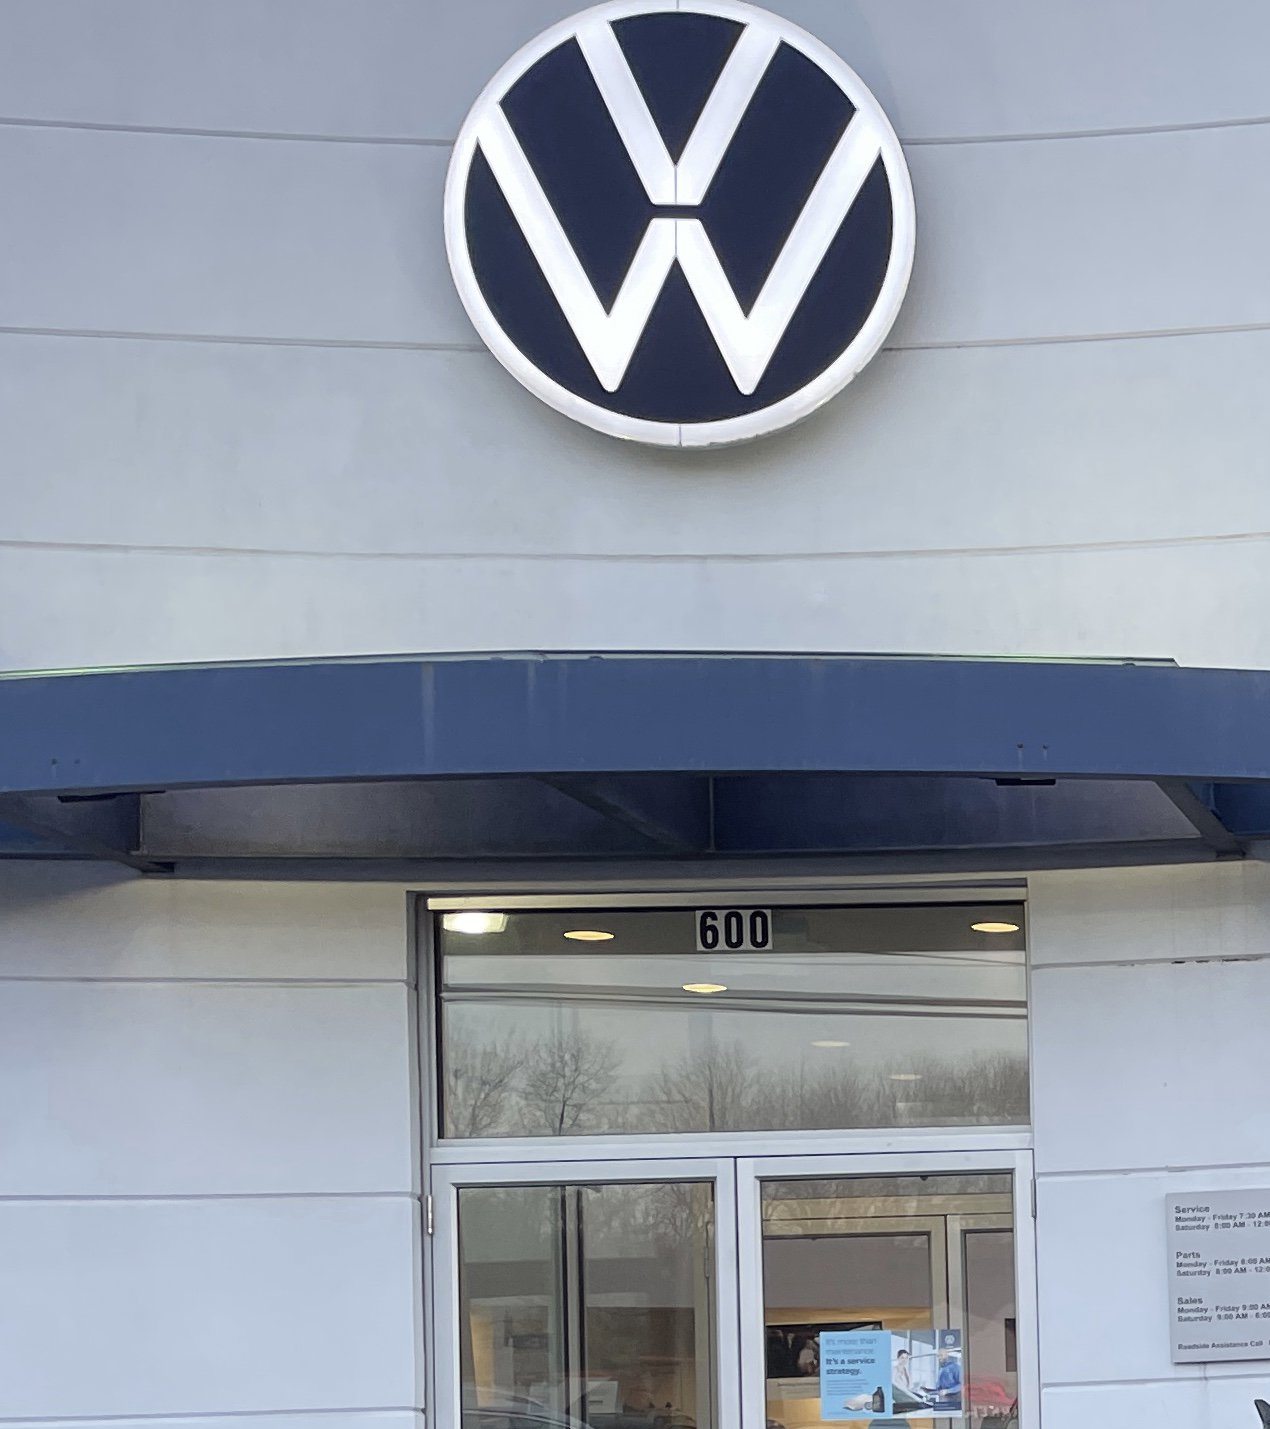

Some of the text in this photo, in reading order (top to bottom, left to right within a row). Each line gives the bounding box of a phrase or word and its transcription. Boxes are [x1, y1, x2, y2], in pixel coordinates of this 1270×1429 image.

[700, 911, 769, 949] 600
[1175, 1215, 1205, 1223] Monday
[1213, 1214, 1237, 1222] Friday
[1176, 1251, 1200, 1259] Parts
[1176, 1261, 1207, 1269] Monday
[1214, 1259, 1239, 1267] Friday
[1177, 1269, 1211, 1277] Saturday
[1177, 1297, 1203, 1305] Sales
[1177, 1306, 1208, 1314] Monday
[1178, 1315, 1212, 1323] Saturday
